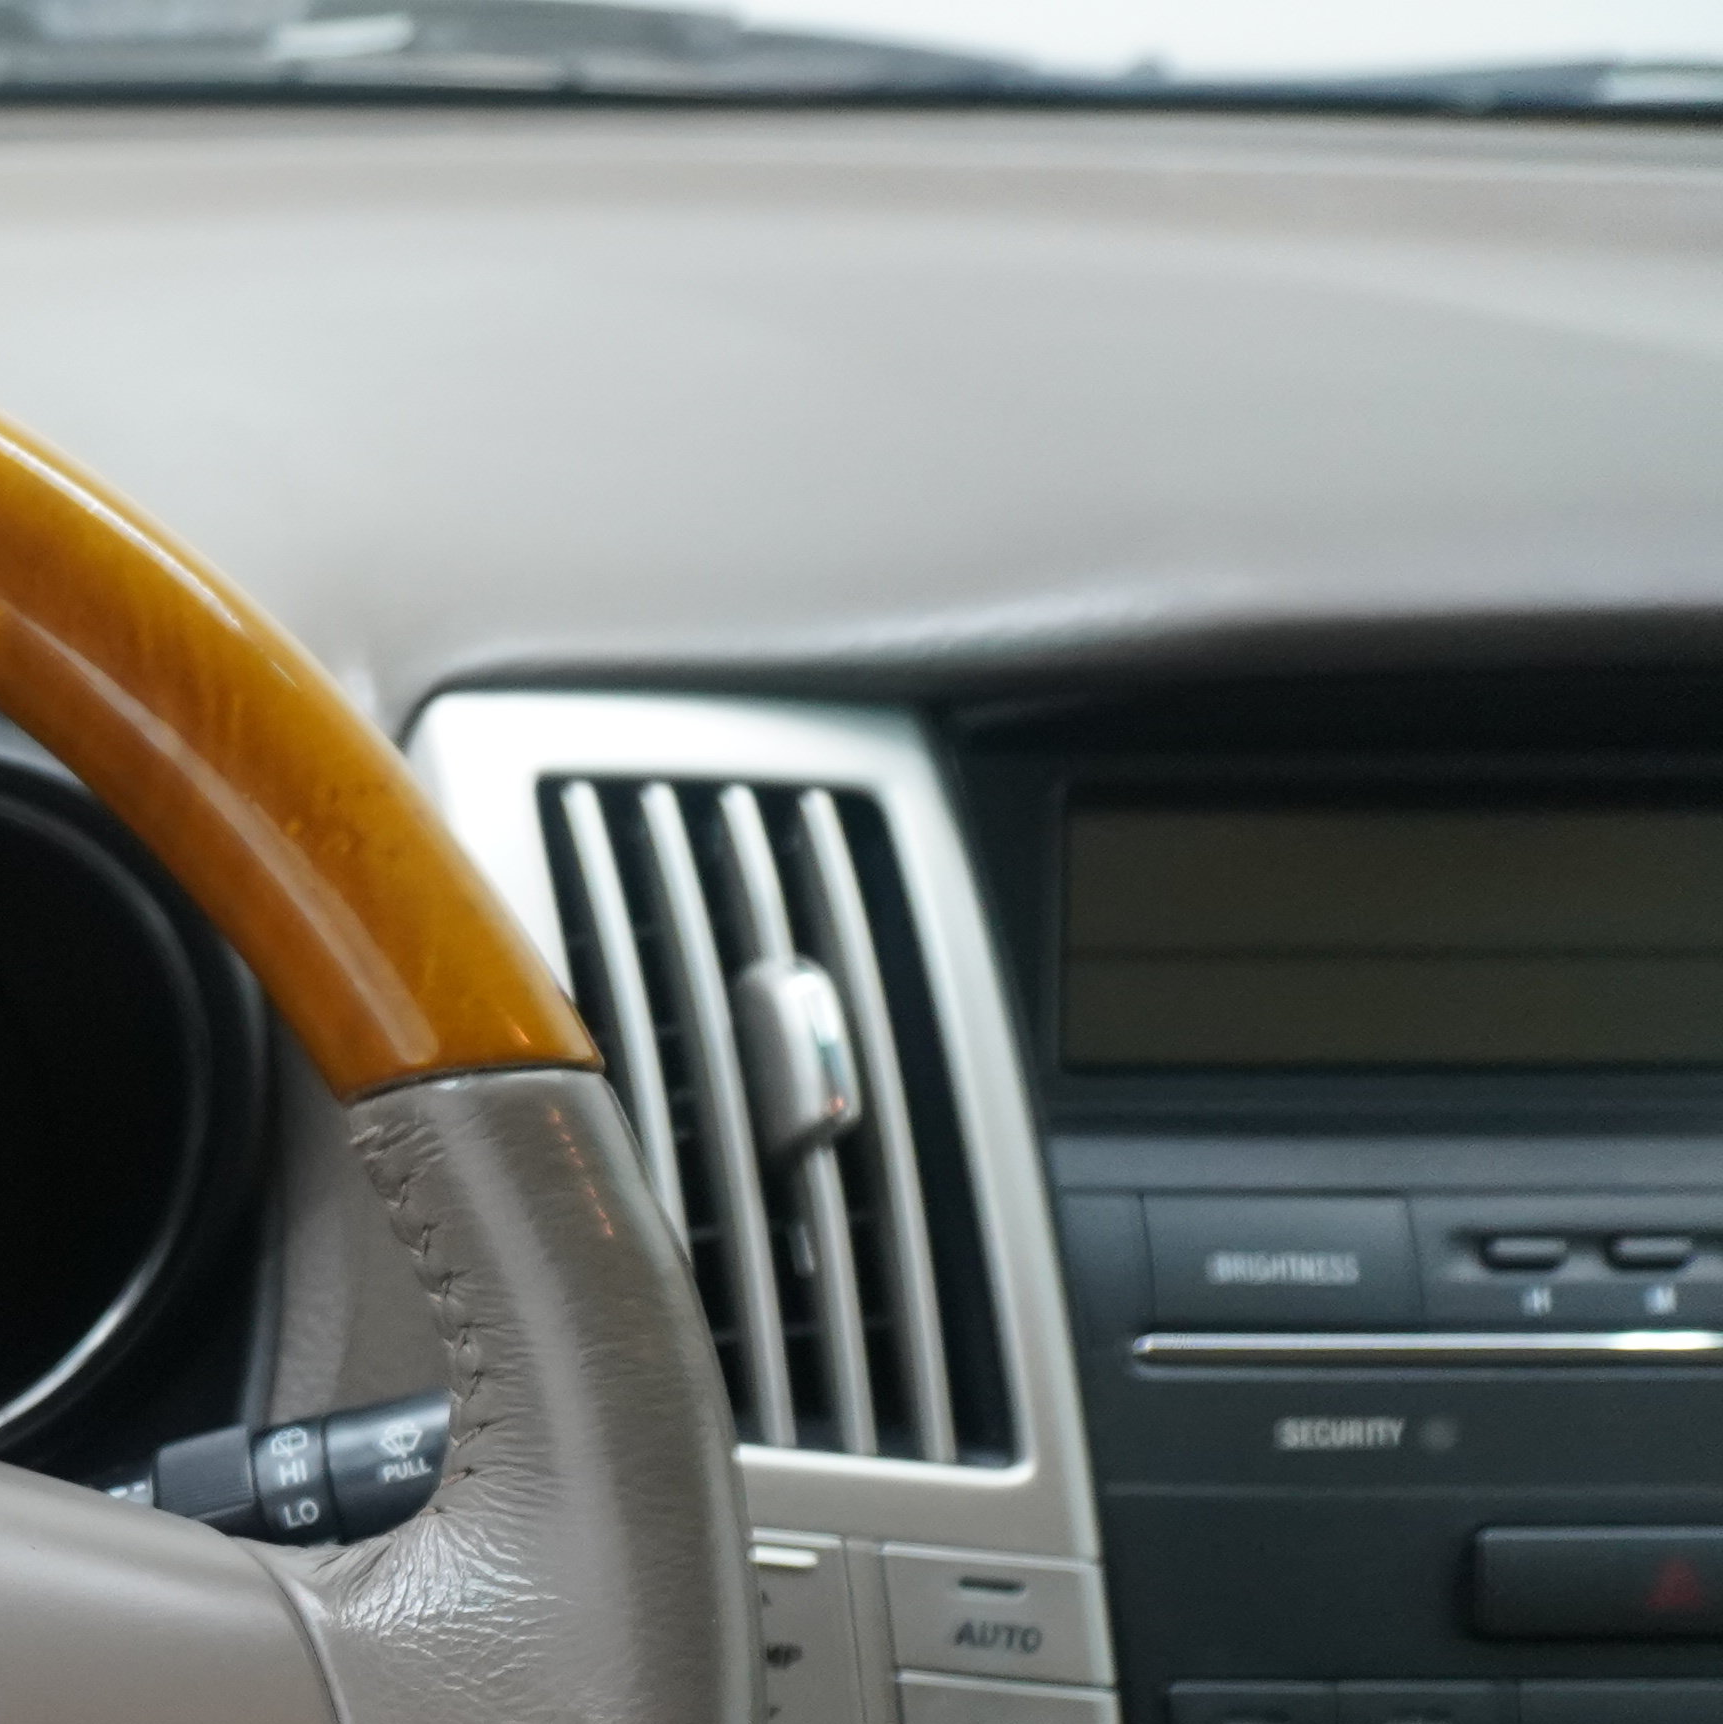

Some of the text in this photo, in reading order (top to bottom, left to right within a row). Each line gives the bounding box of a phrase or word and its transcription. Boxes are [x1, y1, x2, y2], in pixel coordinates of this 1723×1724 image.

[1209, 1252, 1359, 1285] BRIGHTNESS
[1276, 1417, 1406, 1451] SECURITY
[278, 1459, 309, 1487] HI
[381, 1456, 433, 1483] PULL
[283, 1500, 320, 1529] LO
[957, 1621, 1044, 1655] AUTO
